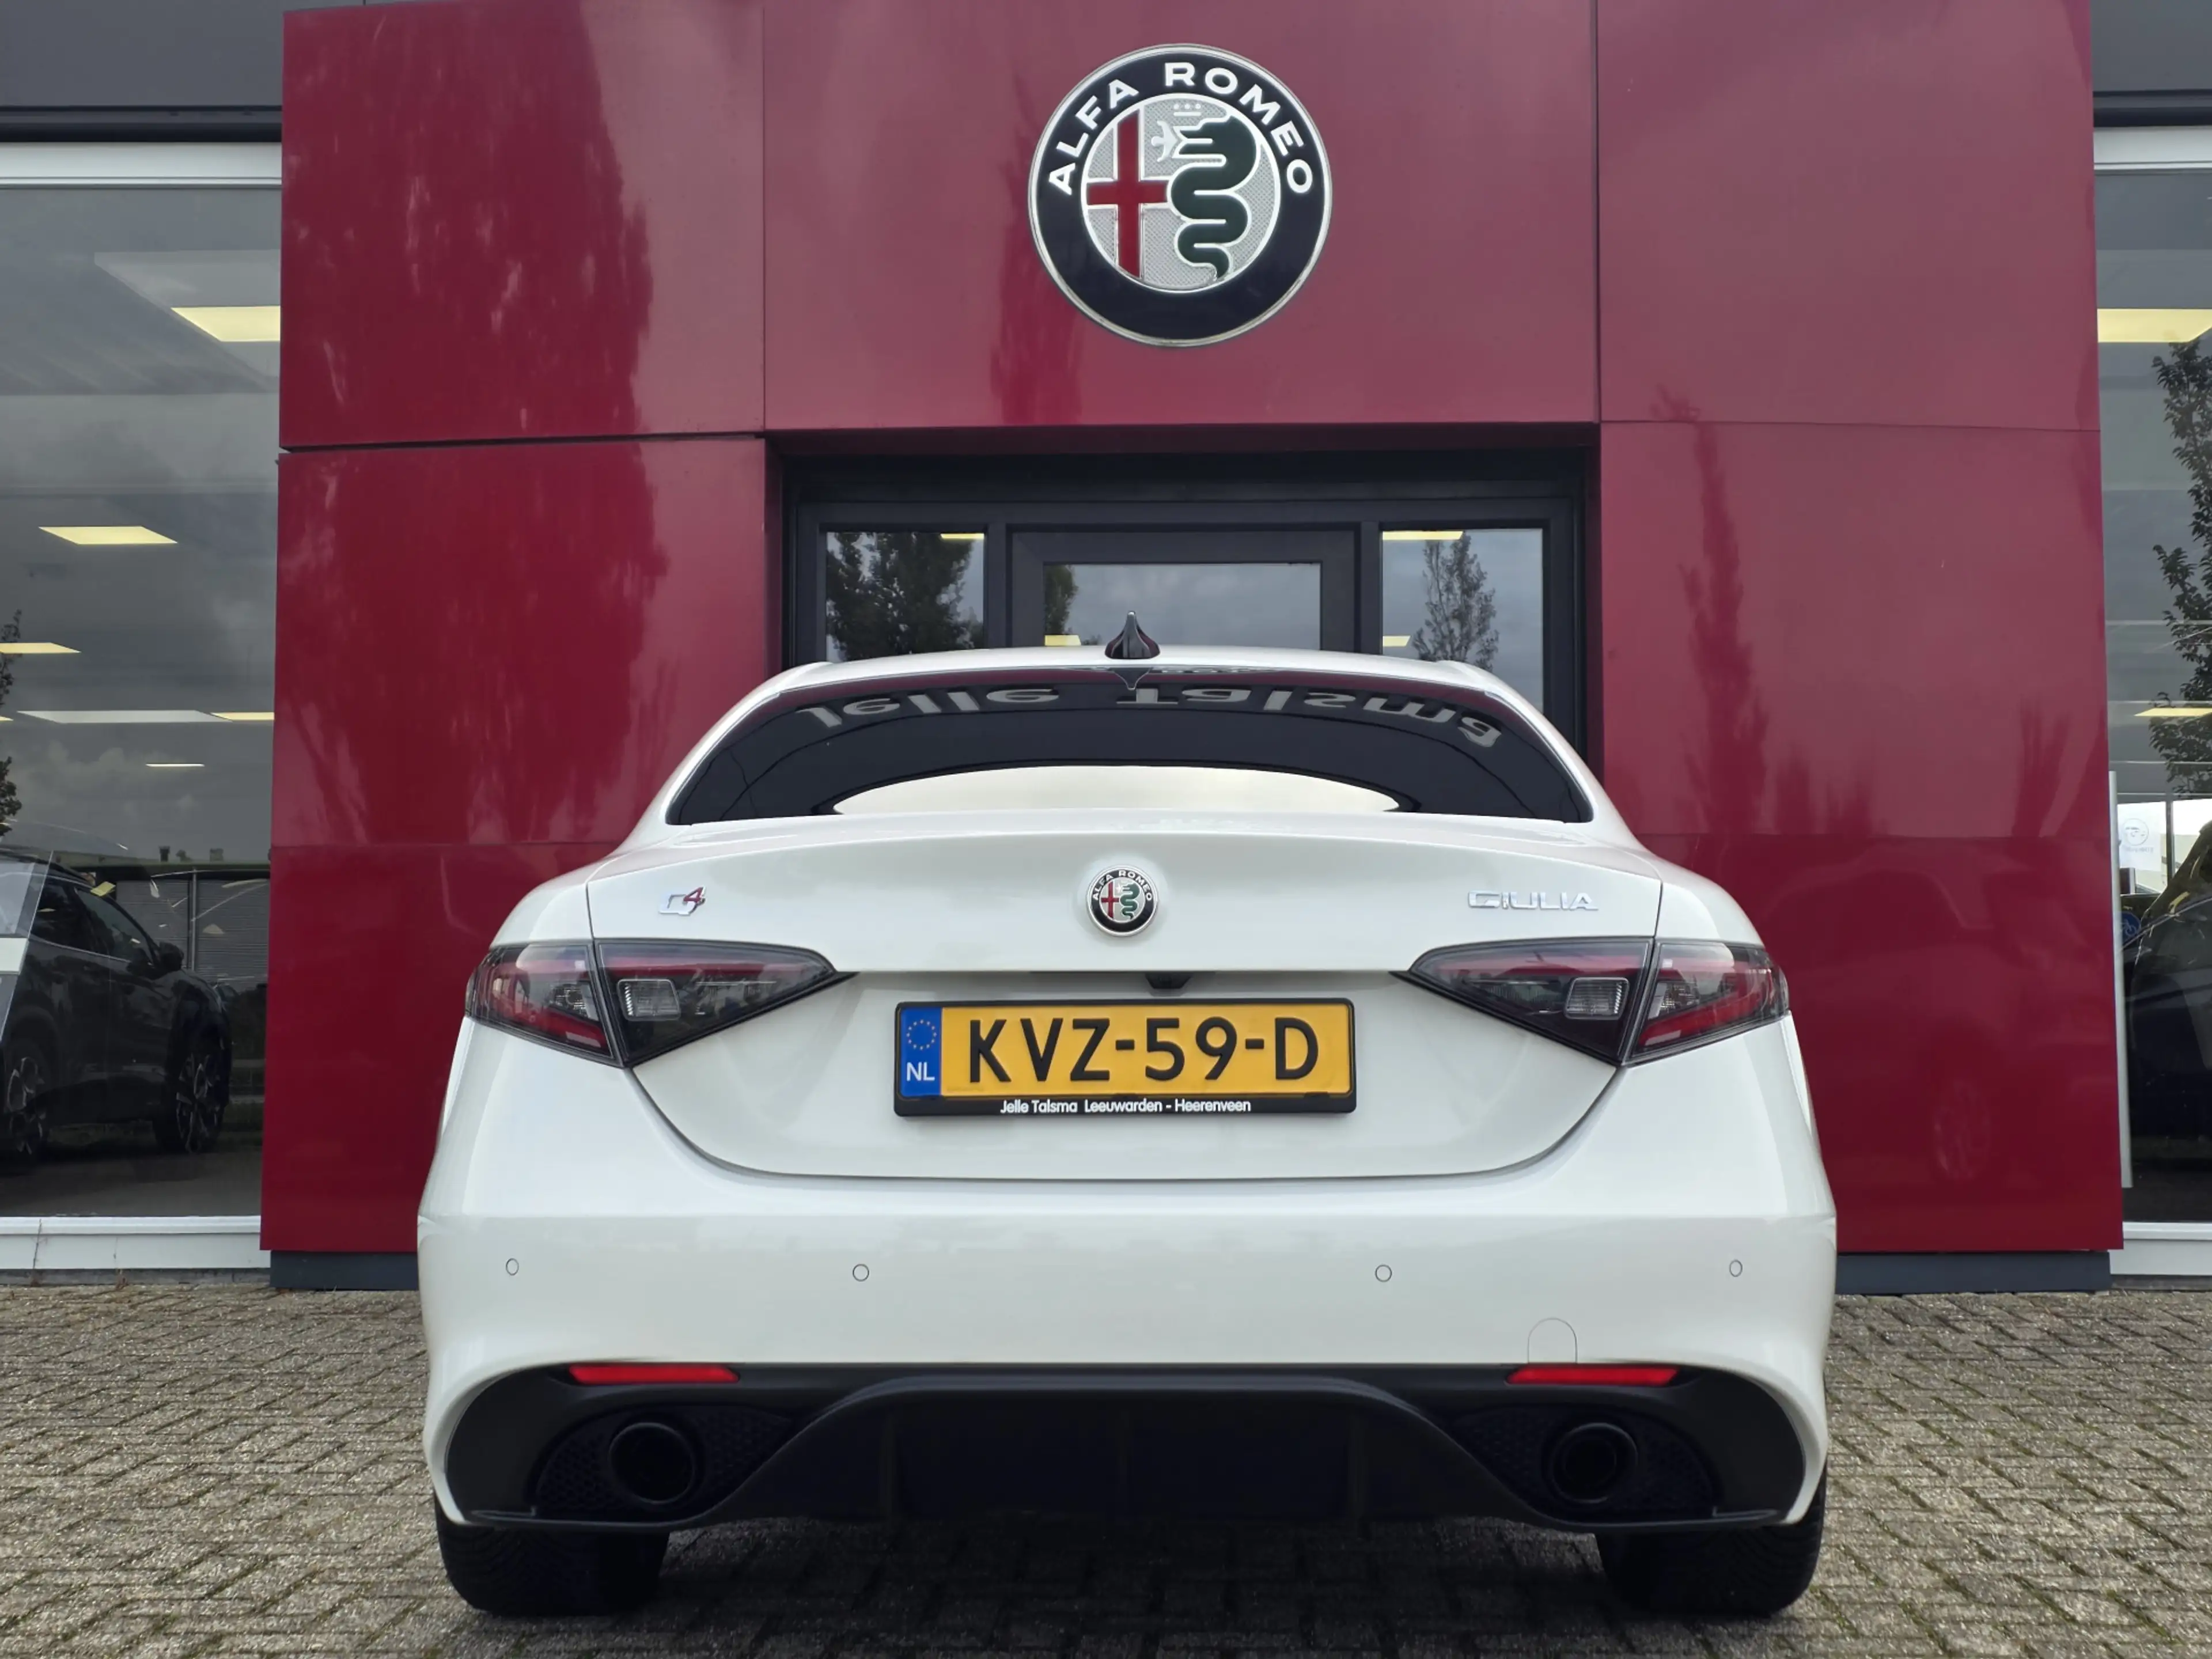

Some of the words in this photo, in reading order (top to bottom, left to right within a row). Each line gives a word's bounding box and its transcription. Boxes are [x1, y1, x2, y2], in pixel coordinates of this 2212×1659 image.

[1048, 78, 1139, 195] ALFA
[1164, 62, 1314, 194] ROMEO
[1092, 874, 1113, 901] ALFA
[1118, 870, 1153, 901] ROMEO
[1468, 891, 1599, 911] GIULIA
[969, 1017, 1319, 1083] KVZ-59-D
[906, 1062, 935, 1082] NL
[1000, 1099, 1029, 1114] Jelle
[1032, 1099, 1078, 1113] Talsma
[1084, 1099, 1162, 1113] Leeuwarden
[1174, 1098, 1252, 1112] Heerenveen
